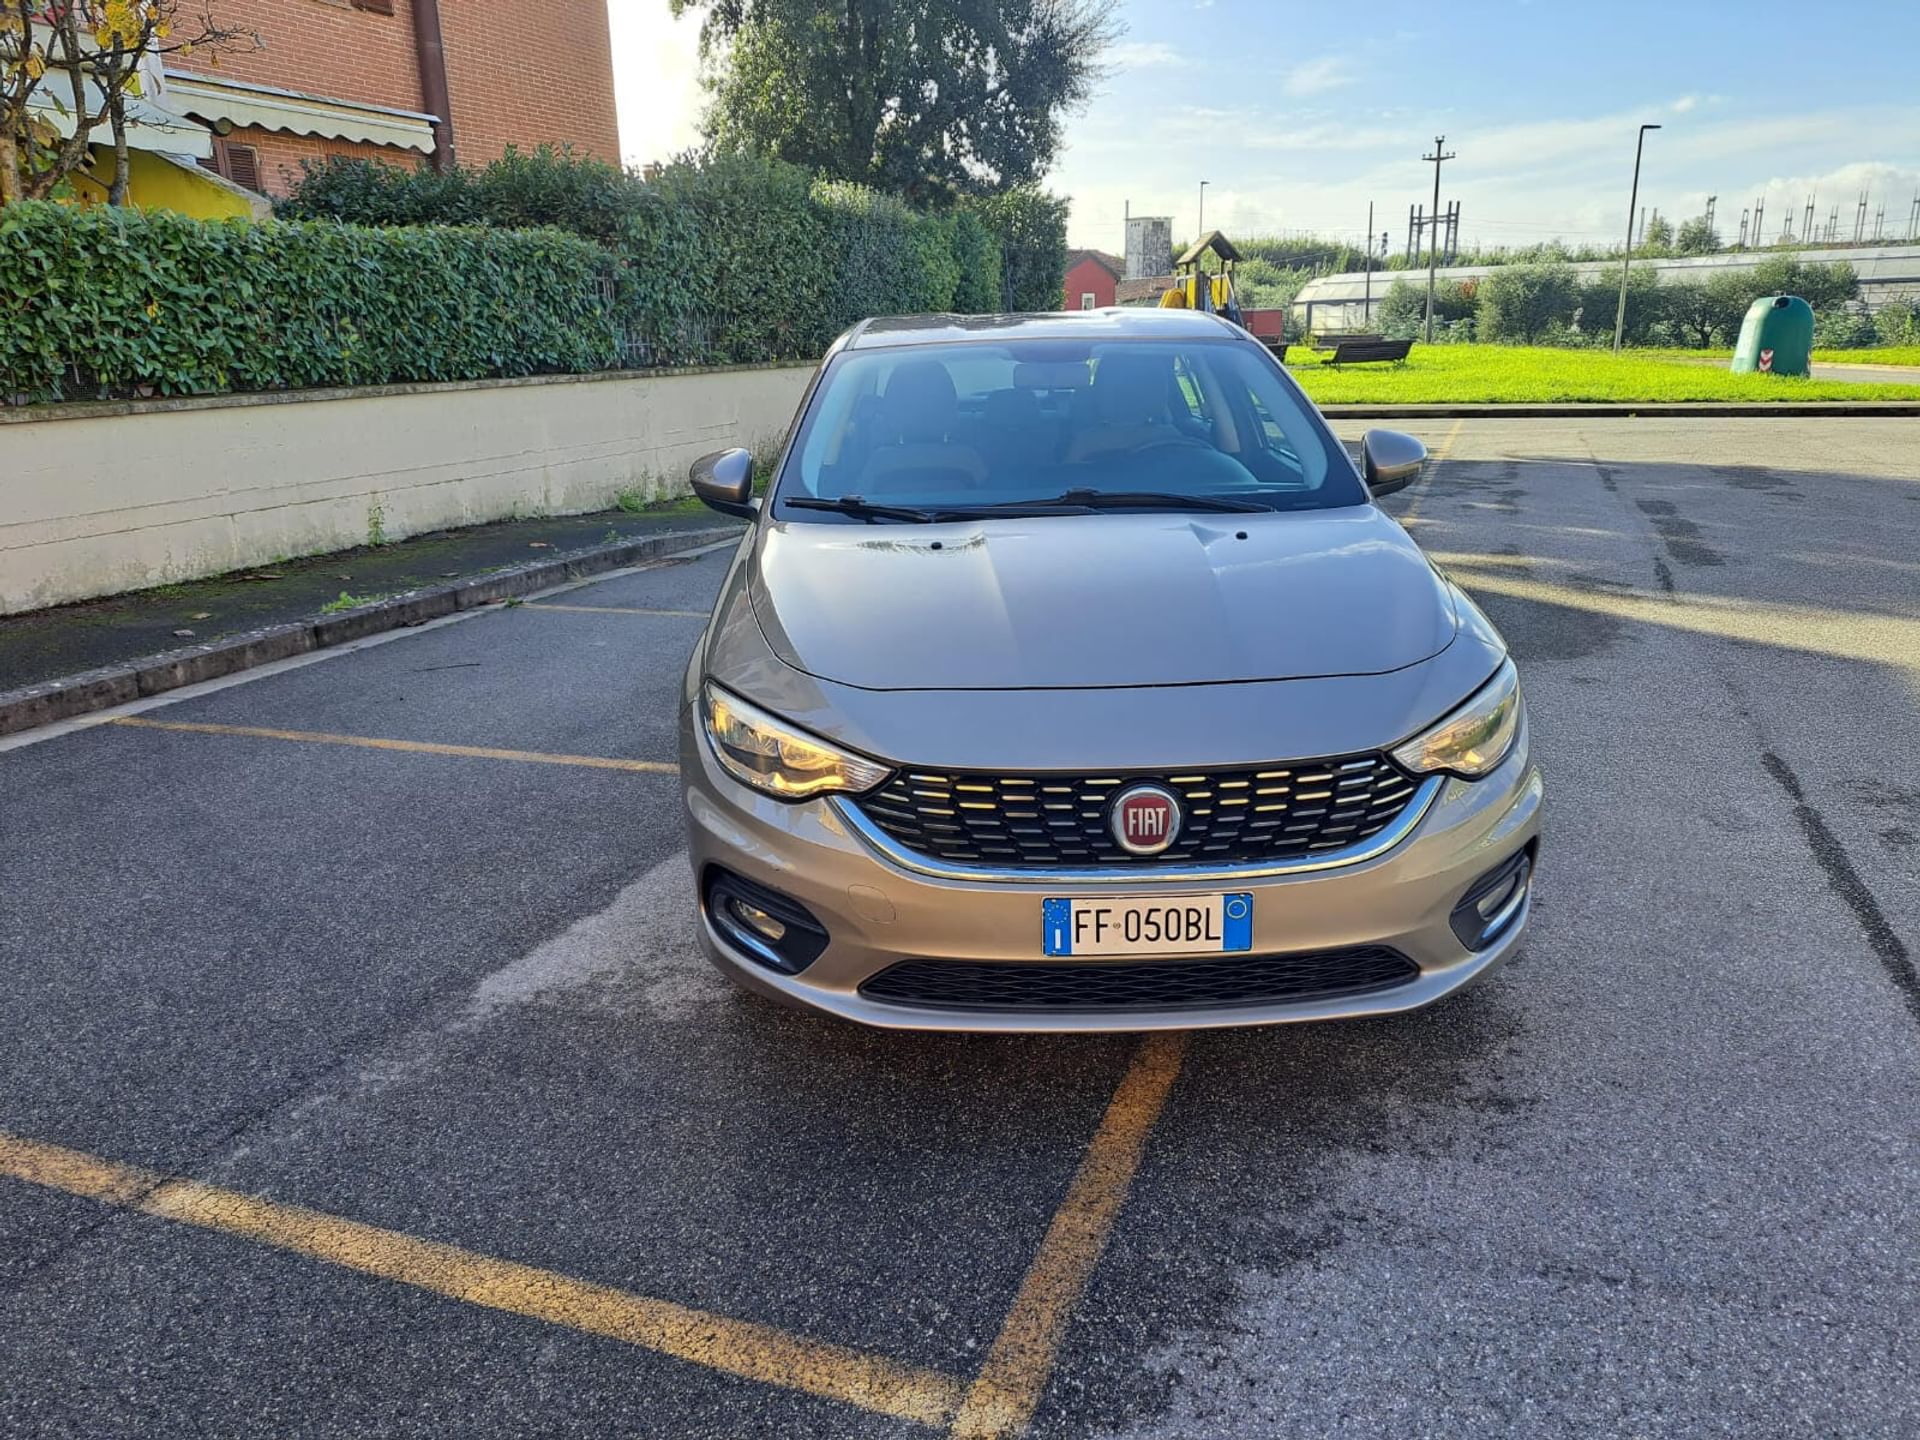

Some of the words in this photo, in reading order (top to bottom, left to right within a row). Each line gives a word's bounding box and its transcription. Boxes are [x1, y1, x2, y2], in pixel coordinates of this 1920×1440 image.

[1128, 807, 1167, 836] FIAT
[1075, 908, 1112, 944] FF
[1124, 907, 1221, 942] 050BL
